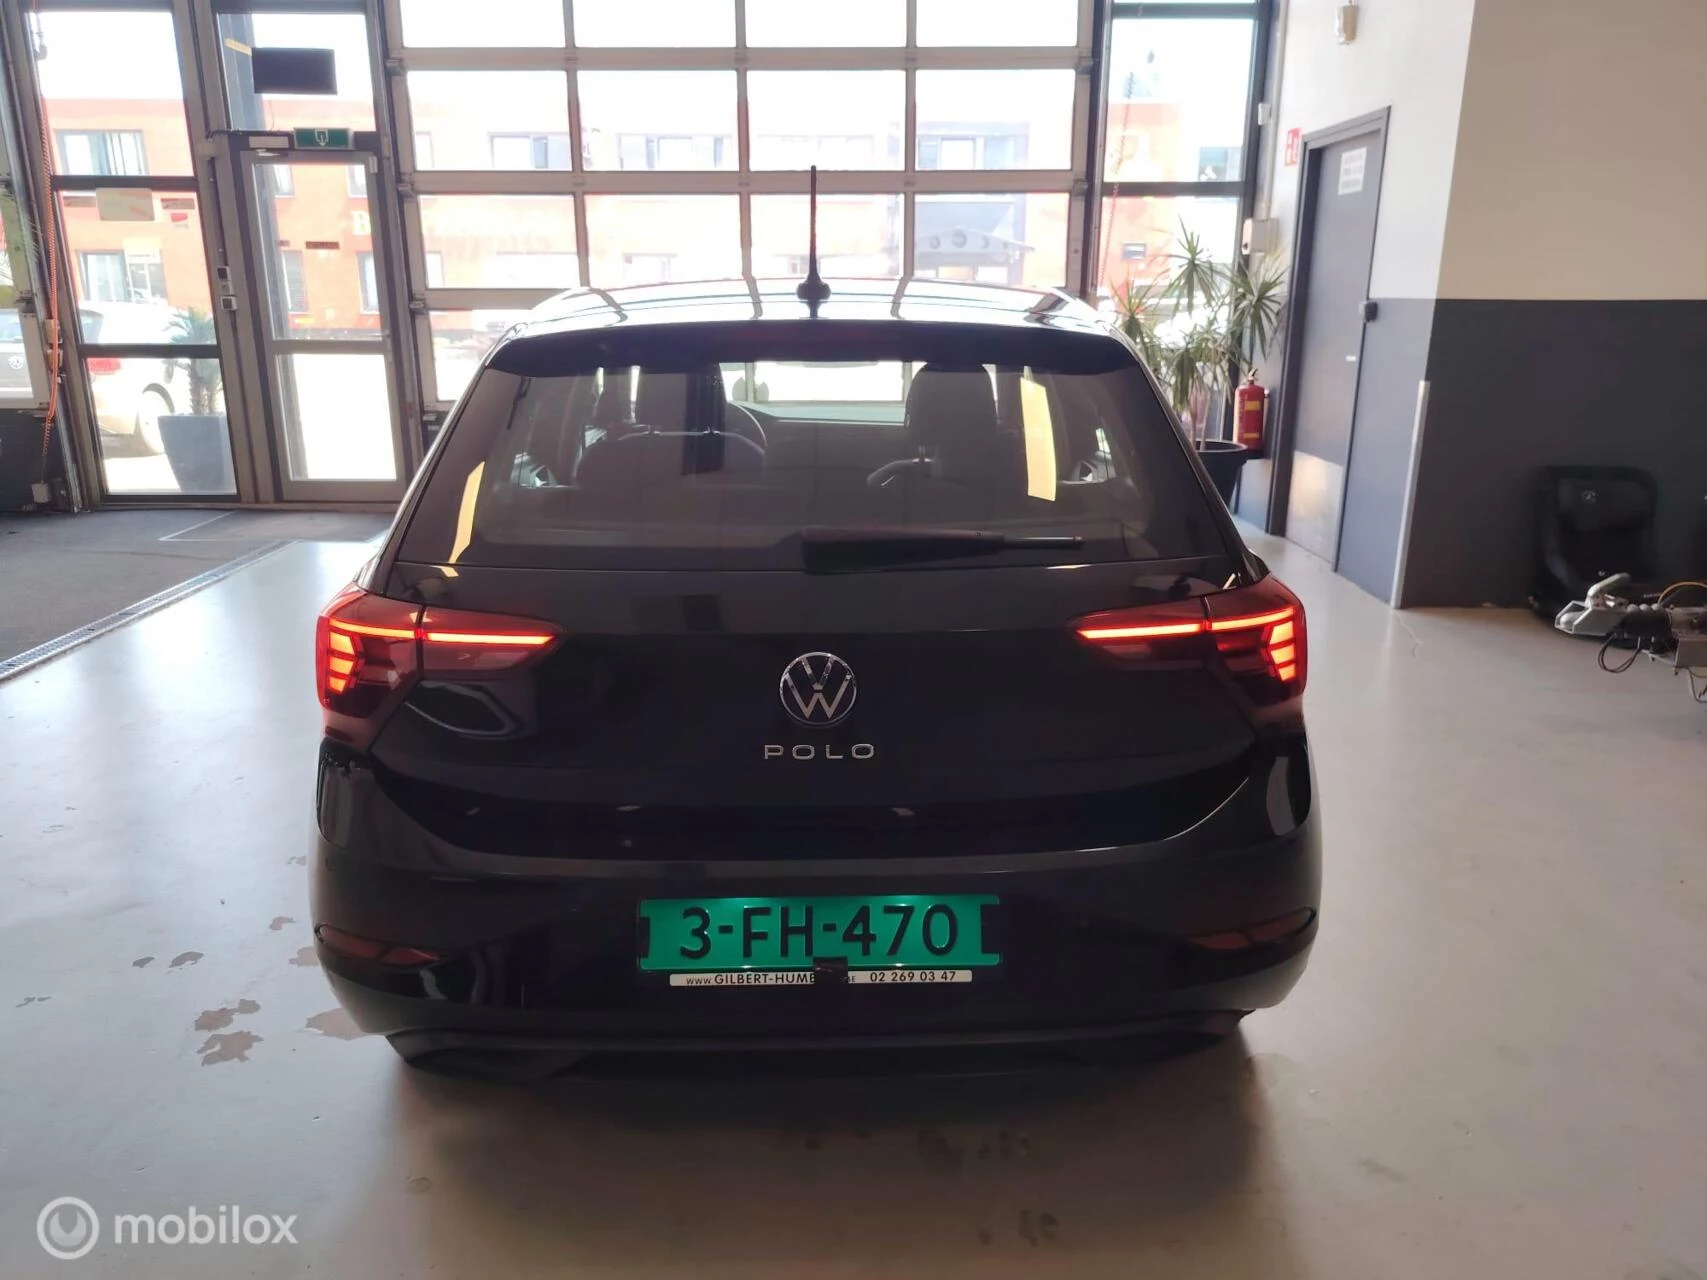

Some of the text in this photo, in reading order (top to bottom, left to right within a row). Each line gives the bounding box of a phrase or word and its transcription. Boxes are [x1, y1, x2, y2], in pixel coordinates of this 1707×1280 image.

[764, 743, 874, 760] POLO
[680, 904, 958, 959] 3-FH-470
[870, 972, 885, 982] 02
[892, 971, 915, 982] 269
[920, 971, 936, 981] 03
[941, 970, 956, 981] 47
